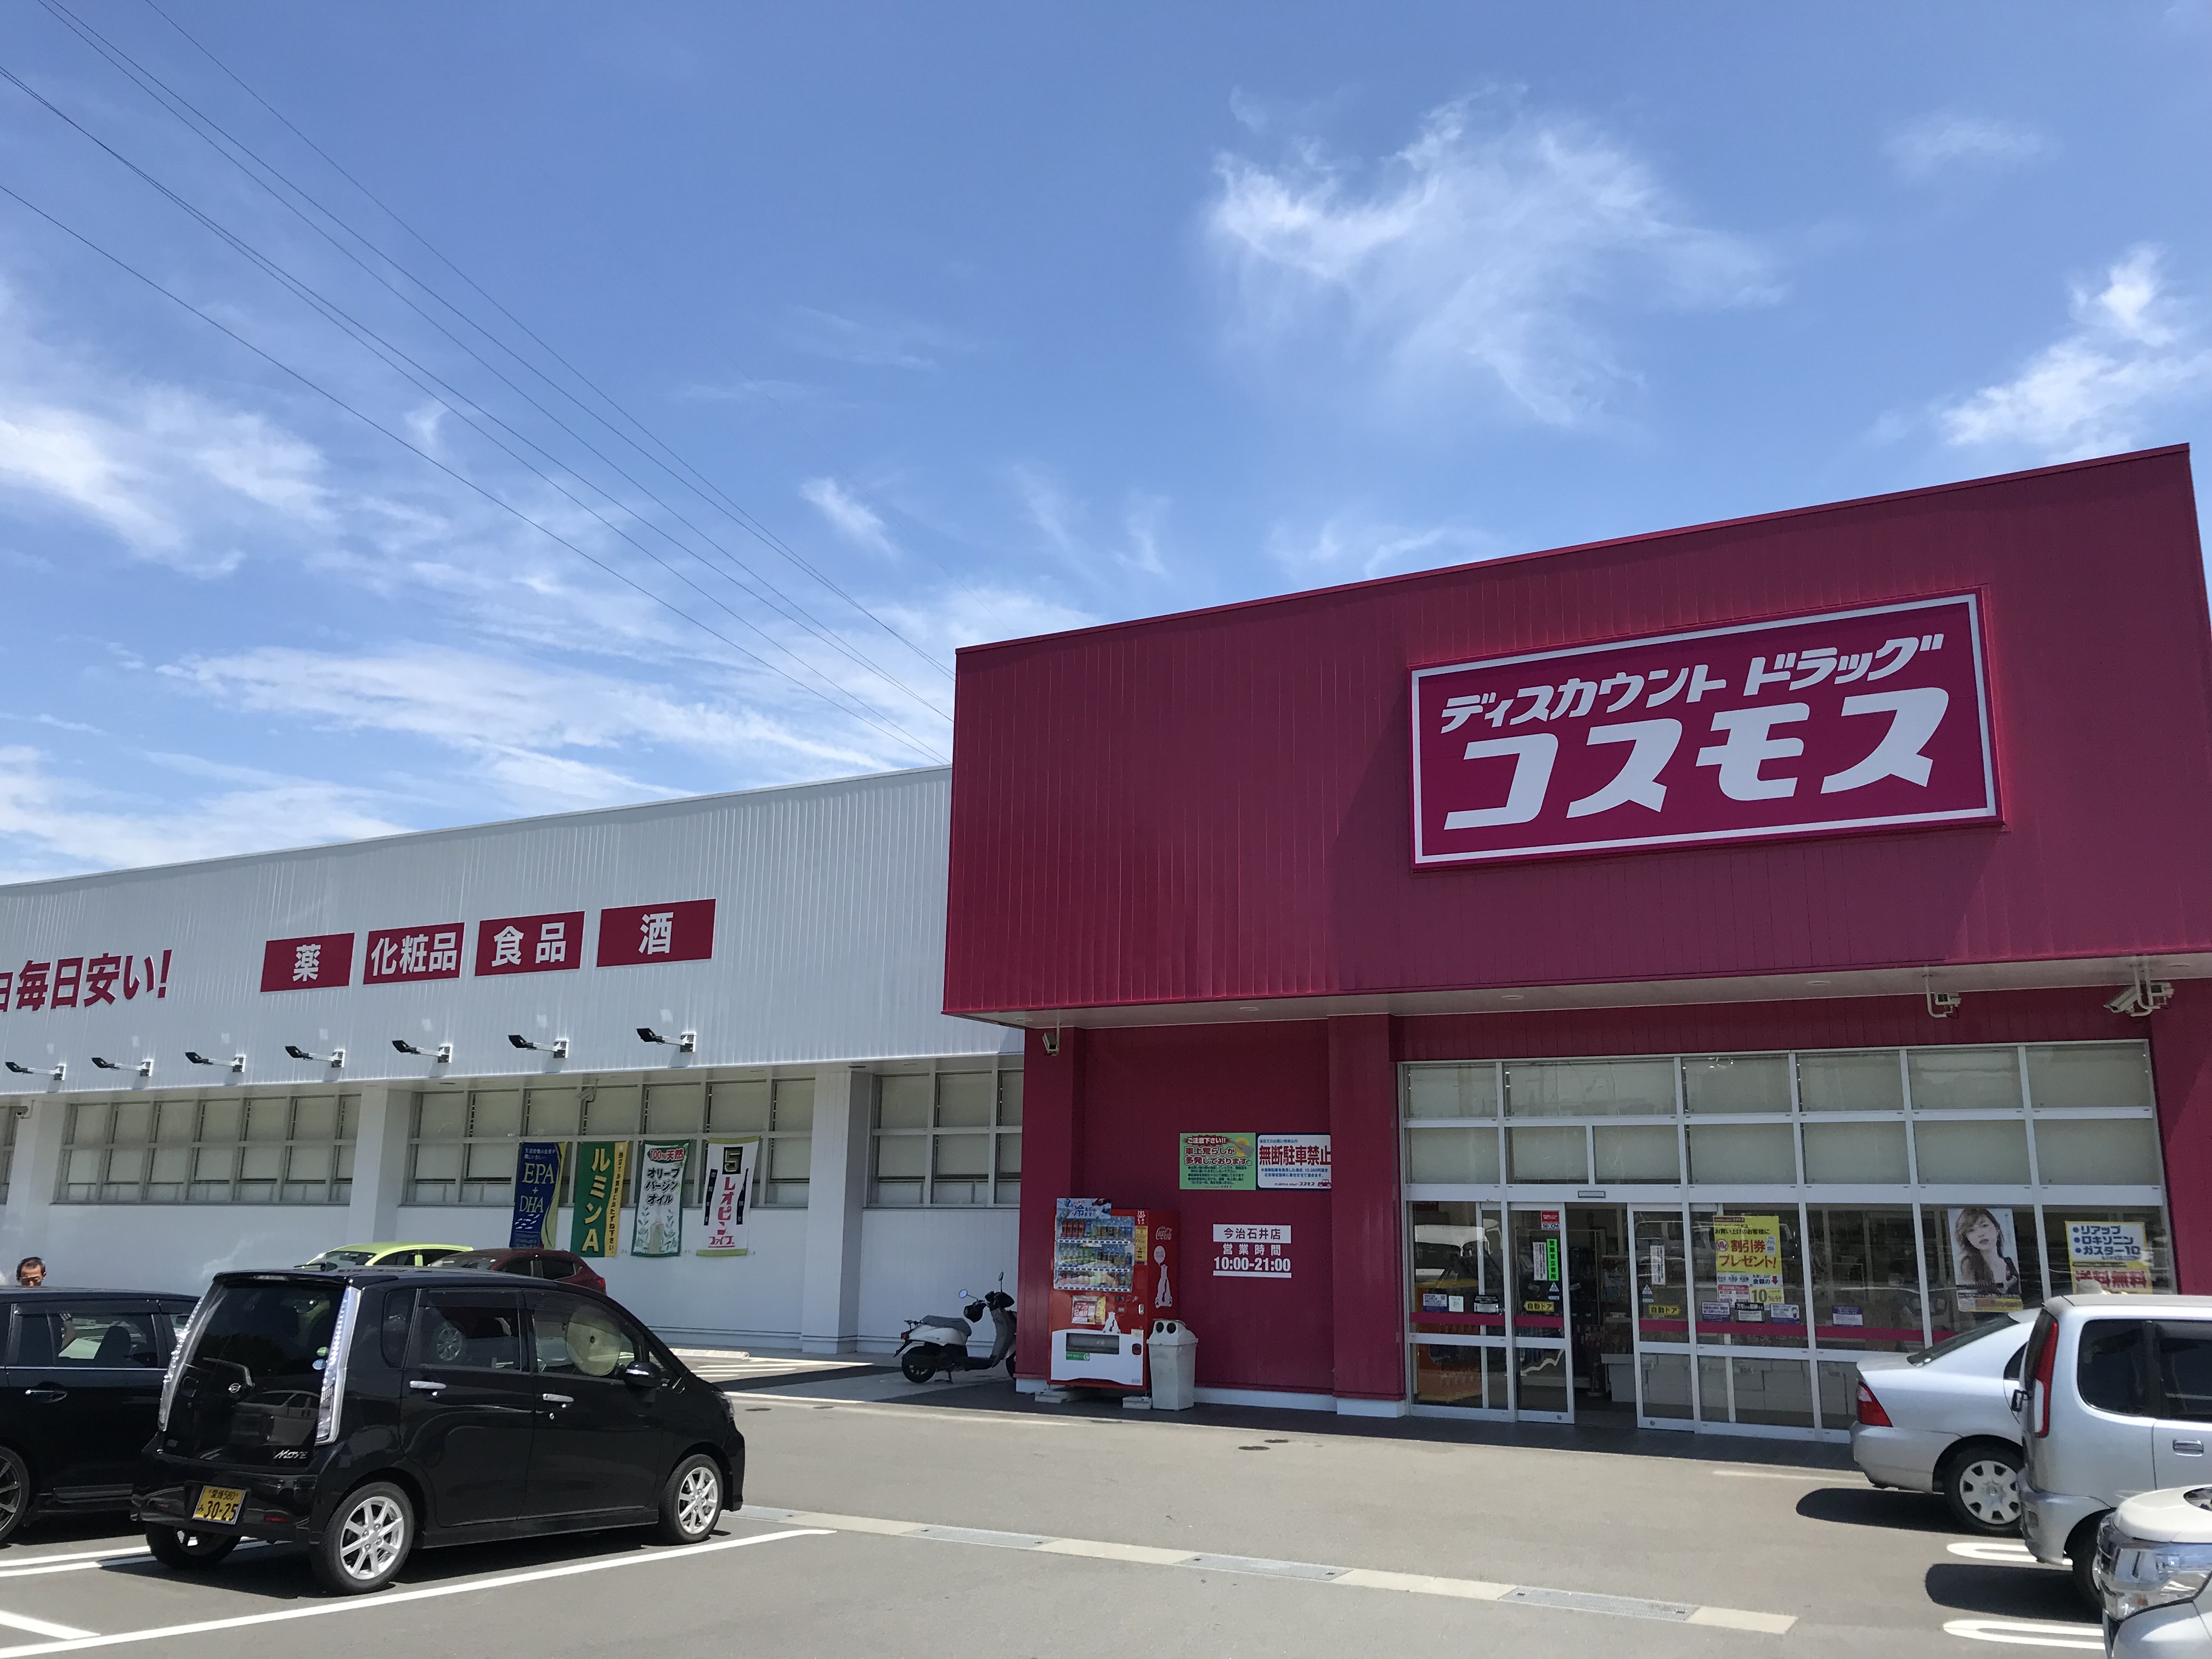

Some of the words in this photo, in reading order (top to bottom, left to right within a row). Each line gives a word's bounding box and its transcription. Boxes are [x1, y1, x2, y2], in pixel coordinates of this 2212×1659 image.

[1441, 664, 1726, 734] ディスカウント
[1743, 634, 1944, 696] ドラッグ
[1443, 687, 1949, 831] コスモス
[638, 912, 674, 955] 酒
[491, 922, 566, 967] 食品
[371, 932, 458, 977] 化粧品
[292, 945, 321, 982] 薬
[650, 1149, 684, 1161] 100%天然
[1185, 1147, 1235, 1155] 車上荒らしが
[1259, 1145, 1331, 1166] 無断駐車禁止
[724, 1149, 741, 1172] 5
[1185, 1156, 1252, 1165] 多発しております。
[522, 1163, 555, 1184] EPA
[645, 1180, 679, 1193] バージン
[519, 1195, 544, 1213] DHA
[580, 1148, 611, 1252] ルミンA
[647, 1194, 674, 1205] オイル
[717, 1176, 736, 1235] レオピン
[1223, 1228, 1281, 1240] 今治石井店
[2081, 1225, 2121, 1235] リアップ
[1730, 1239, 1765, 1253] 割引券
[2081, 1235, 2134, 1245] ロキソニン
[1223, 1243, 1281, 1256] 営業時間
[2083, 1245, 2141, 1255] ガスター10
[1214, 1257, 1291, 1272] 10:00-21:00
[1719, 1254, 1777, 1268] プレゼント!
[203, 1500, 240, 1521] 30-25
